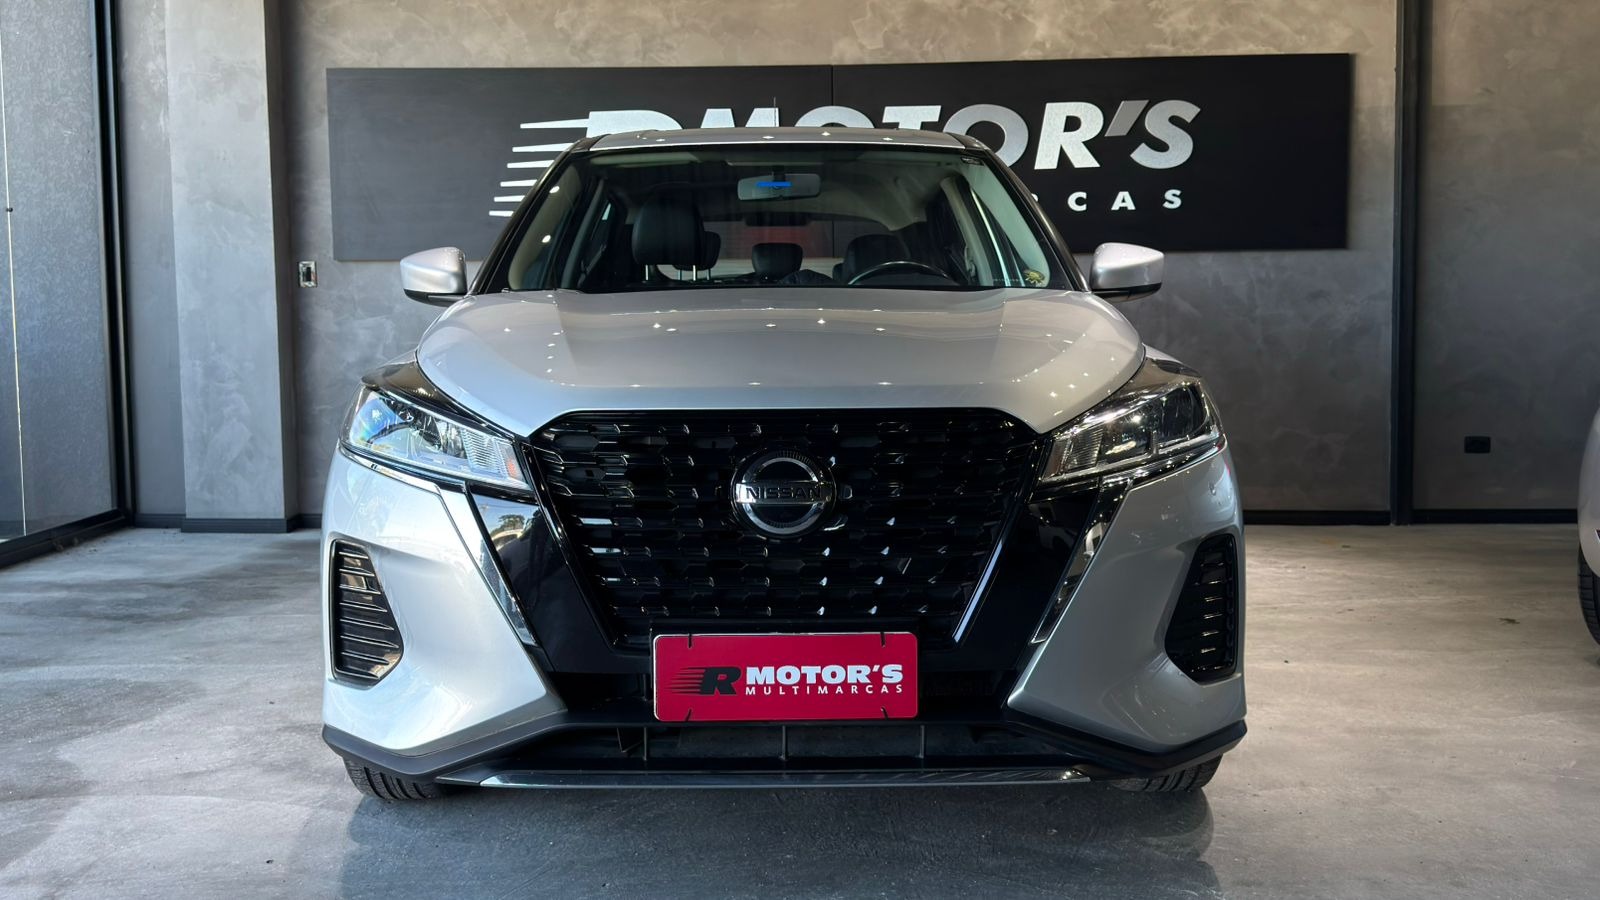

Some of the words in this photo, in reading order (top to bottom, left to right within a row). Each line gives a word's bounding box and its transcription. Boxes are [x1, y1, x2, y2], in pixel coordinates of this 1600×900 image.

[746, 486, 820, 500] NISSAN
[698, 666, 742, 695] R
[745, 664, 903, 685] MOTOR'S
[745, 684, 902, 696] MULTIMARCAS
